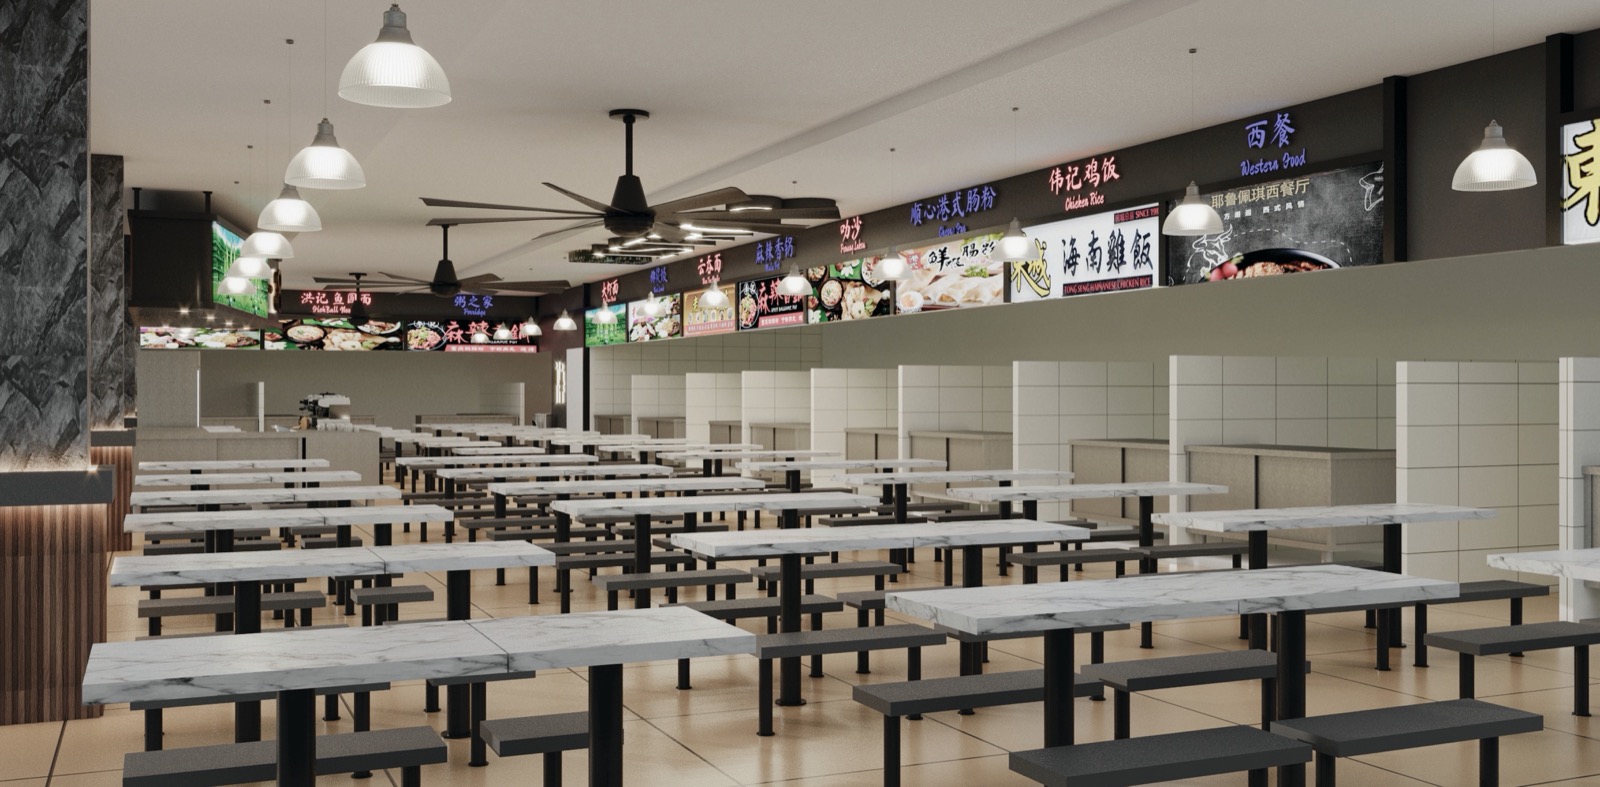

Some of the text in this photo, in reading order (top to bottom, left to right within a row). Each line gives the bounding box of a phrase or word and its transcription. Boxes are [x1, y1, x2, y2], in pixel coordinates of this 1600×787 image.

[1244, 112, 1296, 149] 西餐
[1048, 155, 1120, 196] 伟记鸡饭
[1240, 147, 1306, 177] Western Food
[1064, 190, 1105, 212] Chicken Rice
[1210, 178, 1310, 209] 耶鲁佩琪西餐厅
[1135, 208, 1150, 219] SINCE
[840, 216, 863, 243] 叻沙
[1061, 228, 1154, 277] 海南雞飯
[1116, 278, 1139, 290] CHICKEN
[1139, 277, 1151, 287] RICE
[454, 295, 494, 309] 粥之家
[463, 308, 486, 317] Porridge
